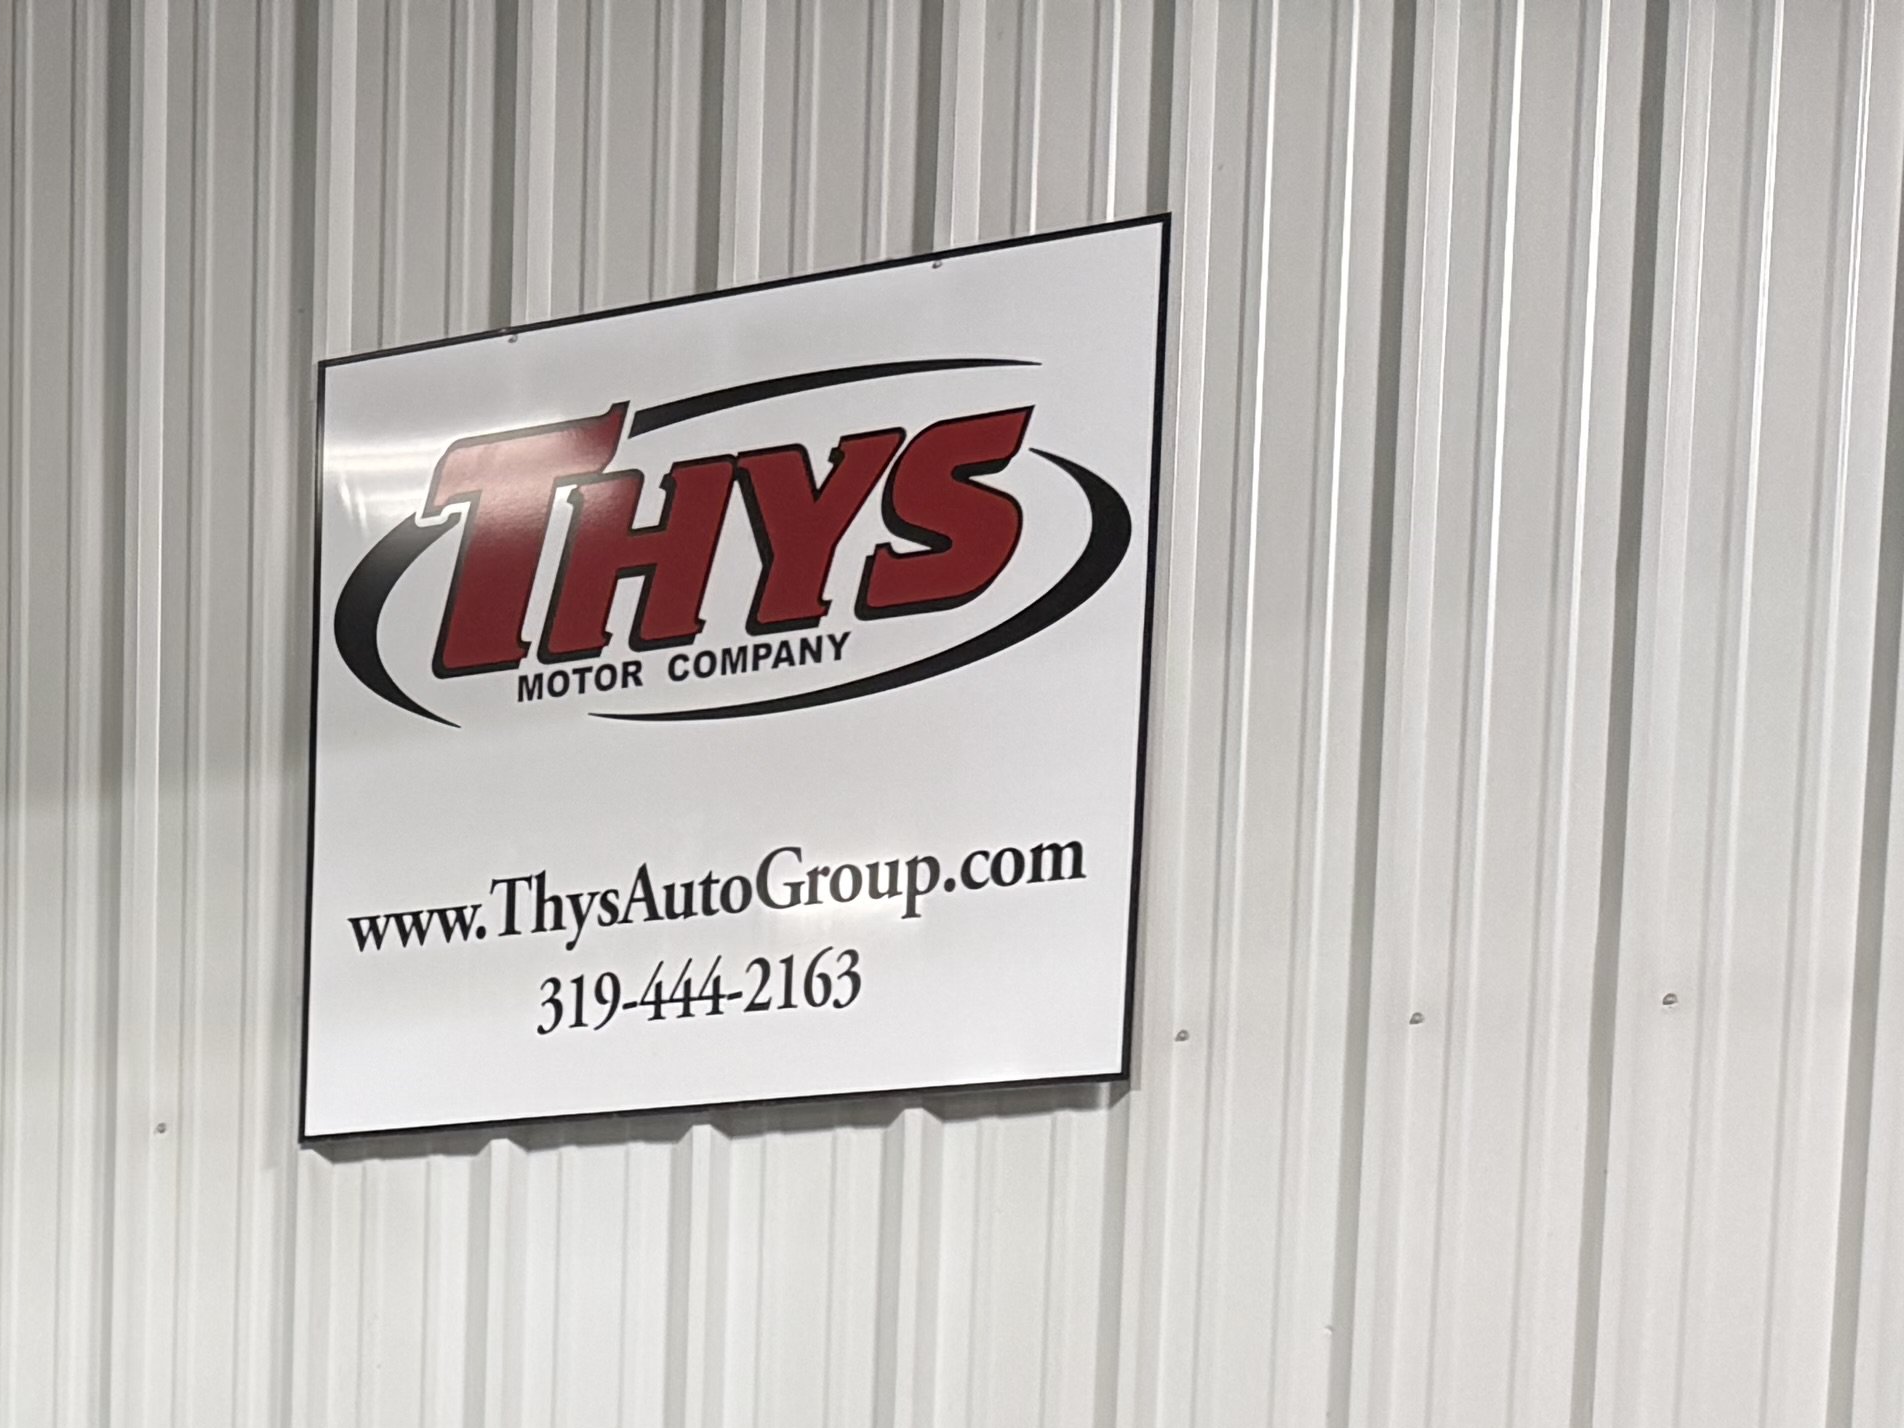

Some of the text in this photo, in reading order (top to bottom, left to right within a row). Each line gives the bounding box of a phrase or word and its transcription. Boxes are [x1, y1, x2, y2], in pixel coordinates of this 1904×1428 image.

[430, 401, 1036, 679] THYS
[516, 630, 852, 703] MOTOR COMPANY
[347, 838, 1087, 954] www.ThysAutoGroup.com
[535, 947, 863, 1035] 319-444-2163
